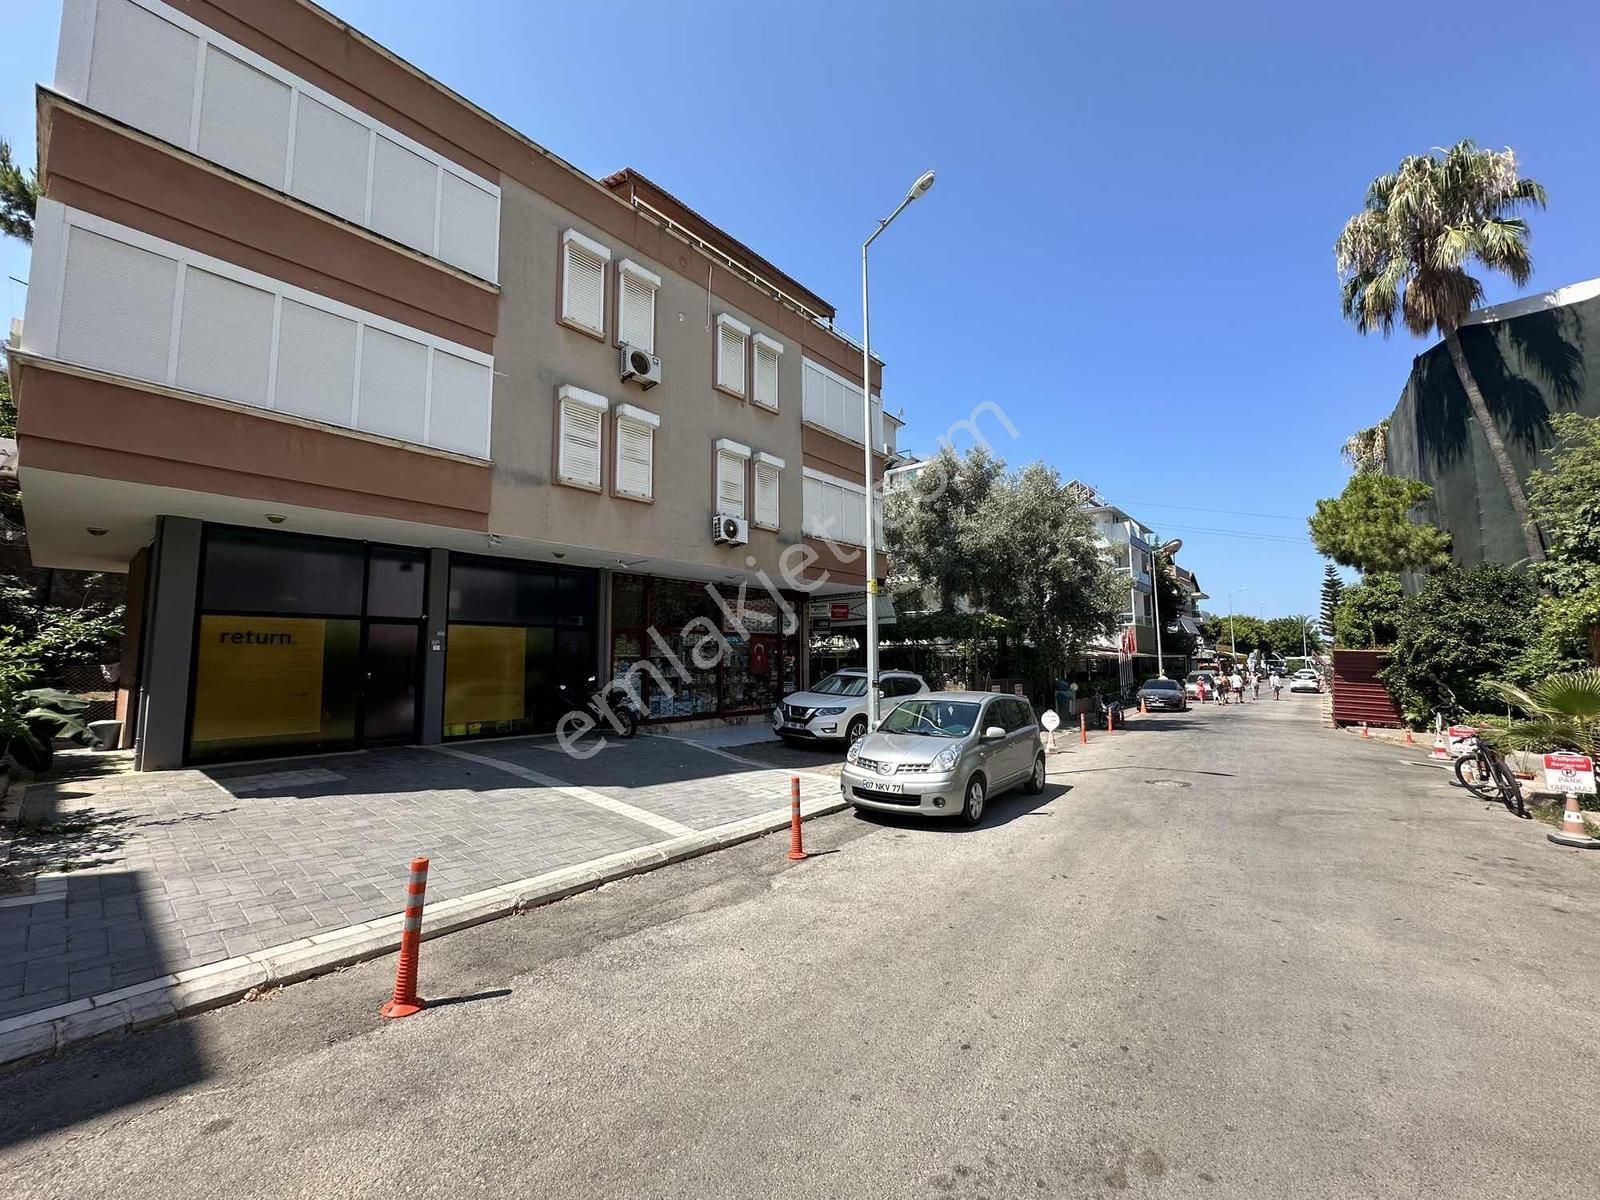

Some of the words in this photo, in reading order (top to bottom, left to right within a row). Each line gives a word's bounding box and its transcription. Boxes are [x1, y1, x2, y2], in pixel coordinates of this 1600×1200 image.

[866, 781, 874, 789] 07
[875, 783, 890, 791] NKV
[892, 784, 901, 792] 77
